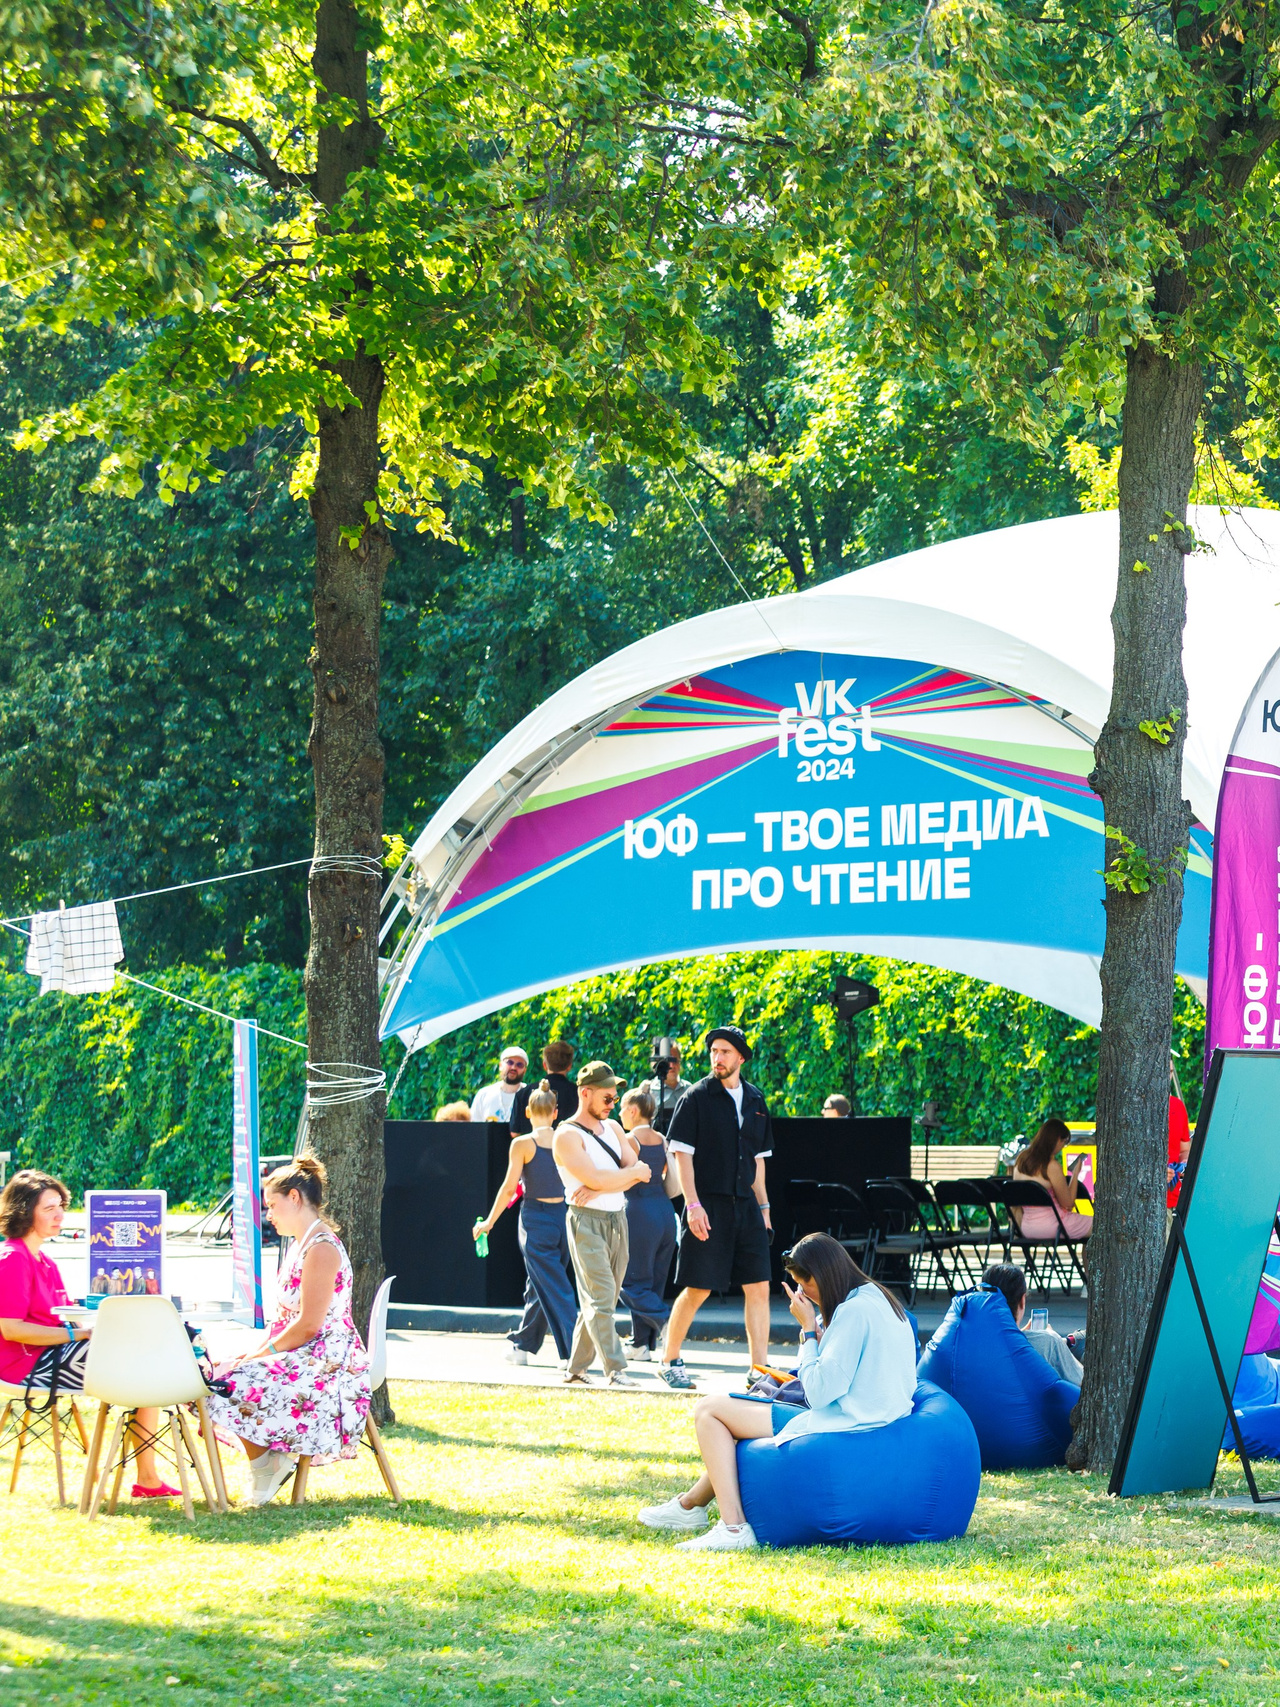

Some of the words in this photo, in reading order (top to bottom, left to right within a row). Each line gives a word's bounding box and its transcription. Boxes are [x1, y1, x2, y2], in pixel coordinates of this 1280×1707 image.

[795, 678, 859, 717] VK
[778, 705, 881, 758] fest
[797, 757, 855, 783] 2024
[623, 813, 699, 860] ЮФ
[754, 806, 870, 853] ТВОЕ
[881, 795, 1050, 852] МЕДИА
[692, 866, 785, 911] ПРО
[792, 857, 971, 906] ЧТЕНИЕ
[1243, 964, 1269, 1045] ЮФ
